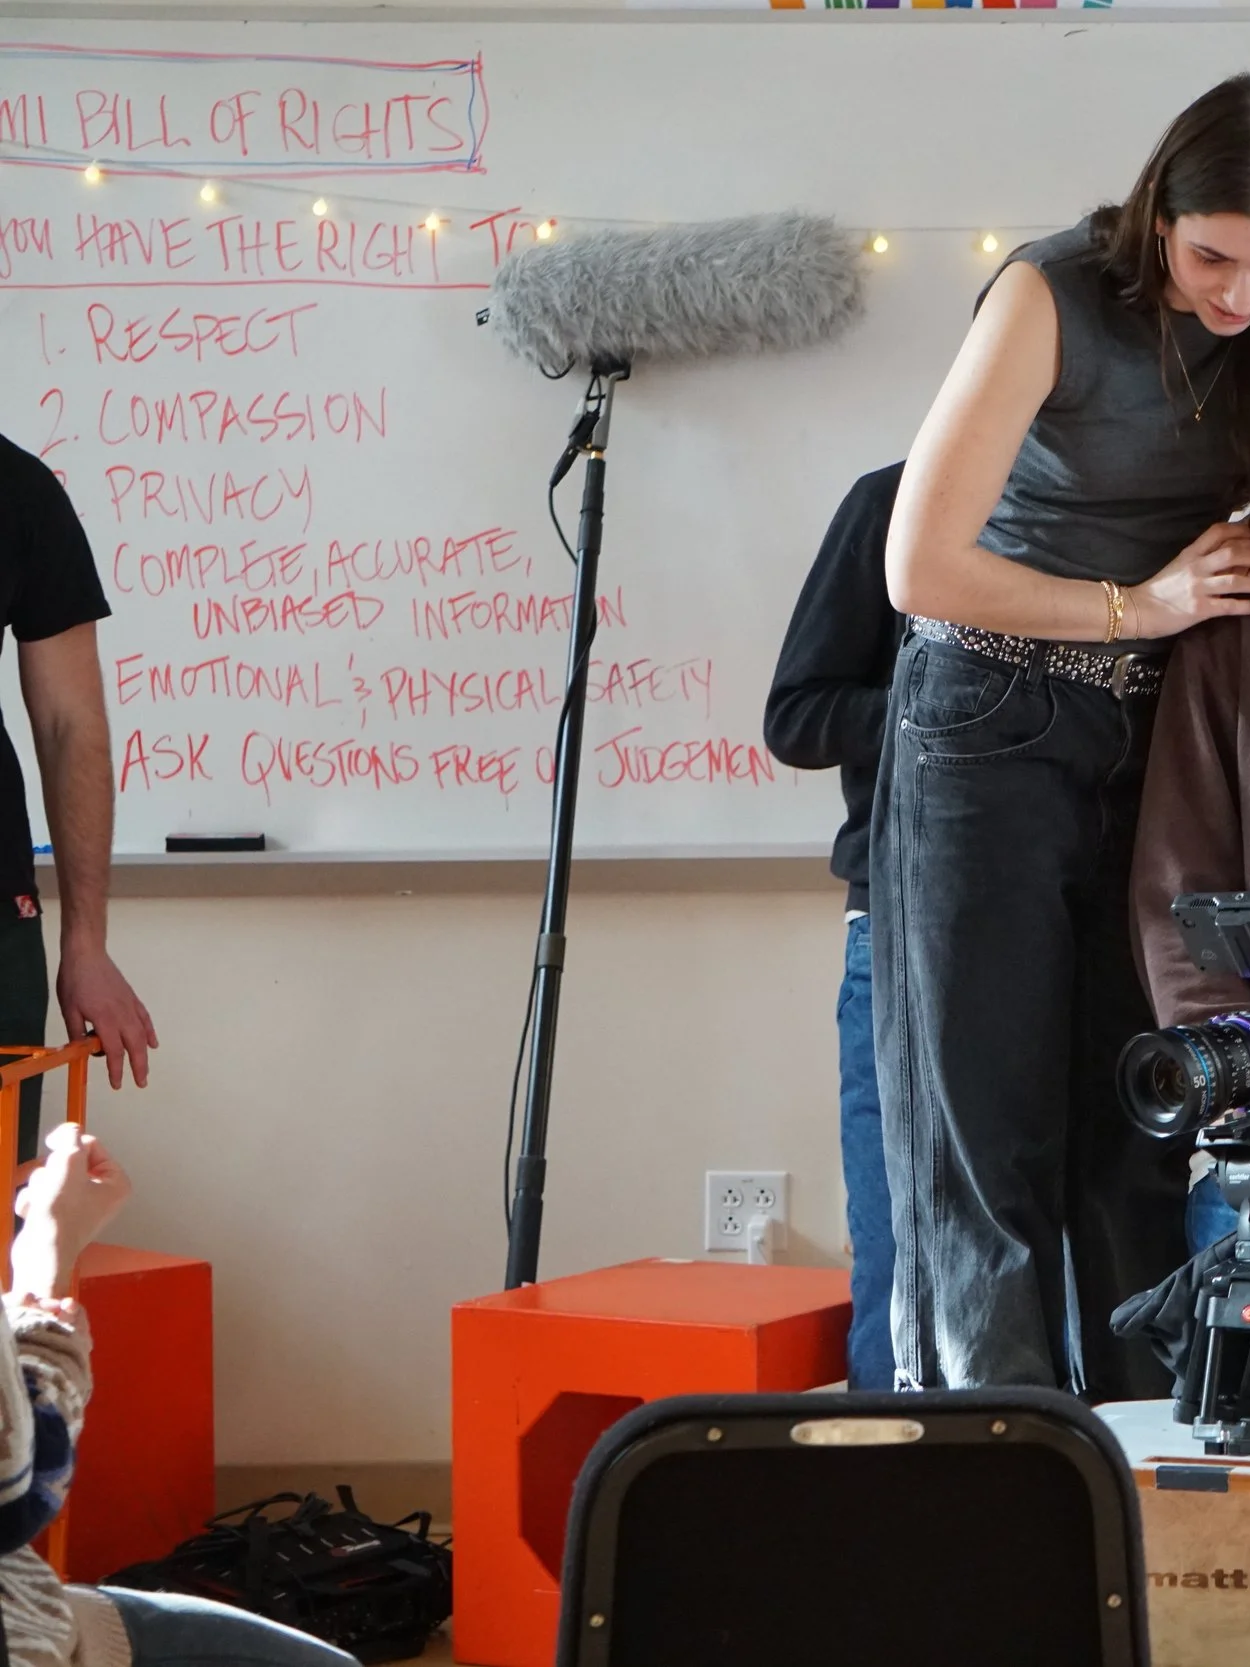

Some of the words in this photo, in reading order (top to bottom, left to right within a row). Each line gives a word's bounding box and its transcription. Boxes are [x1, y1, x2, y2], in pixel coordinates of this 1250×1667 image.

[76, 89, 191, 151] BILL
[209, 90, 262, 156] OF
[279, 88, 465, 158] RIGHTS
[75, 212, 196, 270] HAVE
[206, 213, 302, 274] THE
[318, 217, 452, 283] RIGHT
[87, 303, 319, 364] RESPECT
[39, 388, 80, 458] 2.
[99, 386, 386, 445] COMPASSION
[105, 464, 313, 534] PRIVACY
[113, 540, 319, 597] COMPLETE,
[328, 527, 534, 587] ACCURATE,
[193, 590, 385, 640] UNBIASED
[412, 585, 628, 641] INFORMATN
[115, 653, 343, 708] EMOTIONAL
[381, 665, 563, 721] PHYSICAL
[584, 657, 714, 719] SAFETY
[120, 729, 213, 793] ASK
[241, 729, 420, 807] QUESTIONS
[428, 743, 522, 794] FREE
[594, 726, 799, 787] JUDGEMEN
[1193, 1074, 1206, 1089] 50
